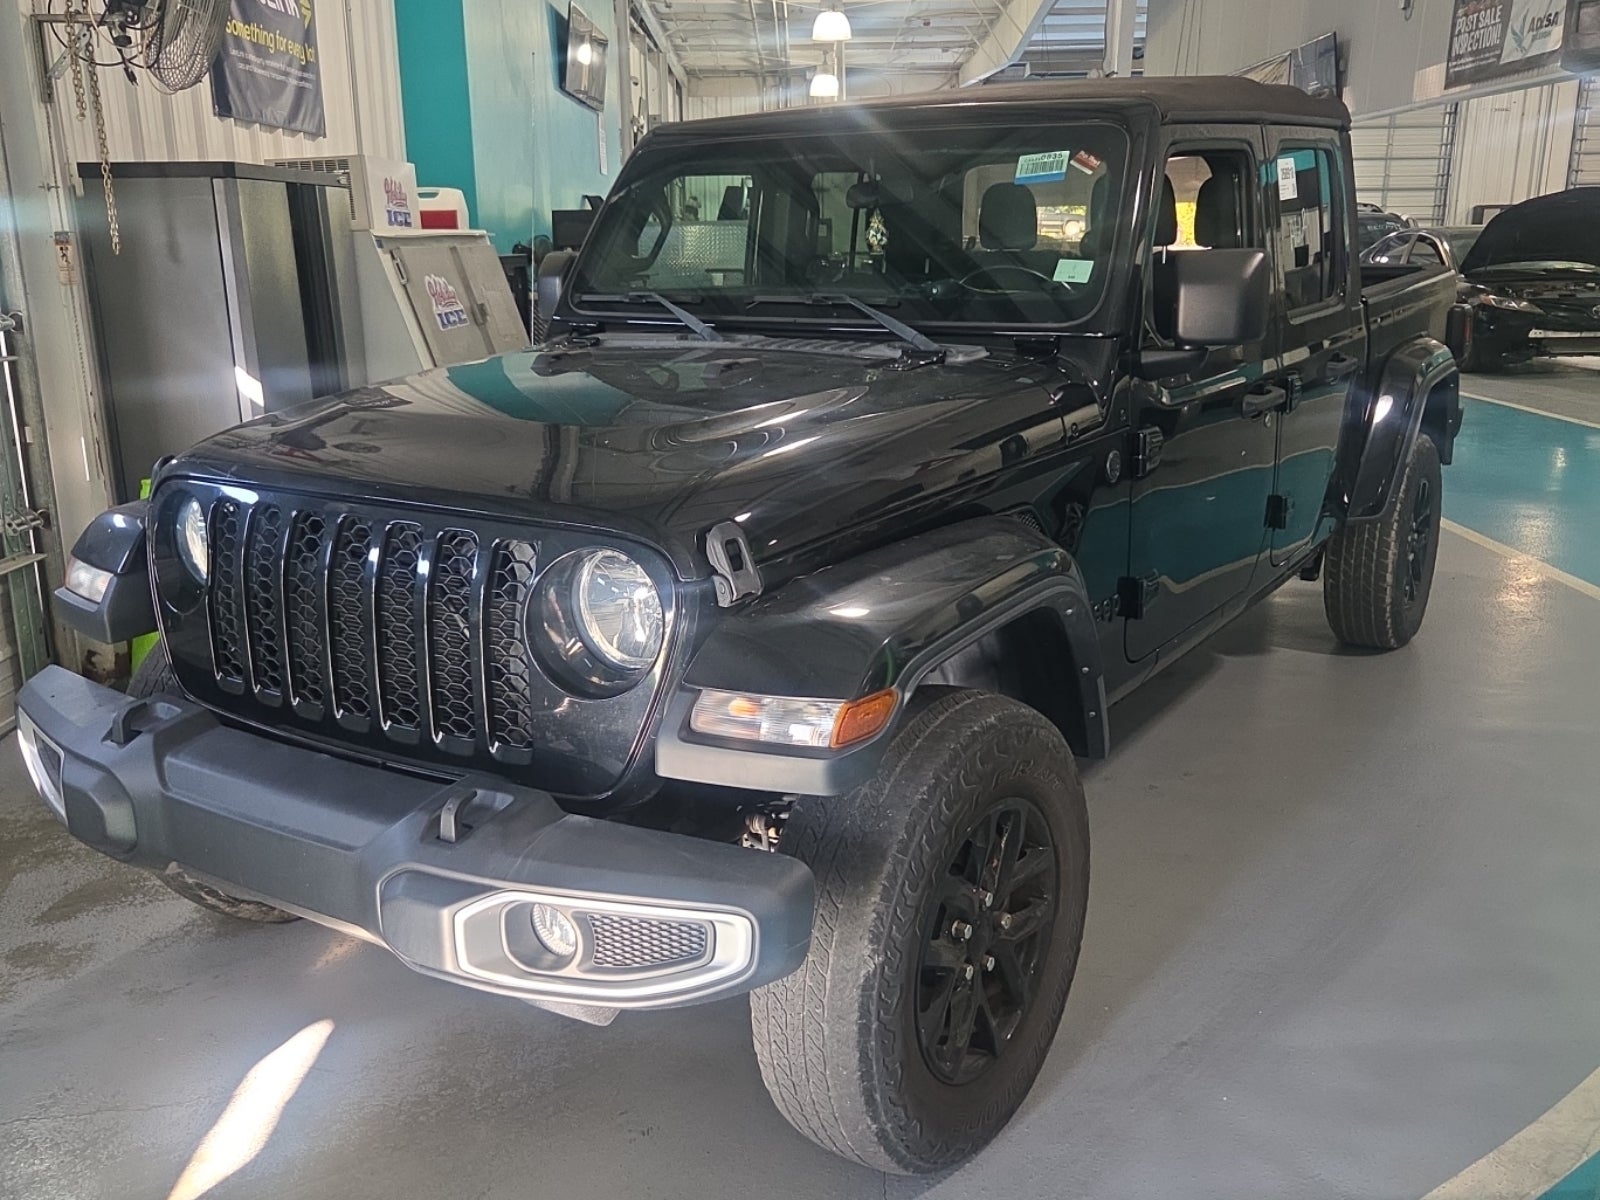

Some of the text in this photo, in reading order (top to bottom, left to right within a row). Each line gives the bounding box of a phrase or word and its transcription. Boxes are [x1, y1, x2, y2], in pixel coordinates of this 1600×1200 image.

[1455, 12, 1479, 36] POST
[1478, 4, 1503, 28] SALE
[225, 20, 275, 54] something
[276, 30, 287, 52] for
[288, 40, 306, 65] every
[386, 209, 412, 228] ICE
[437, 309, 469, 330] ICE
